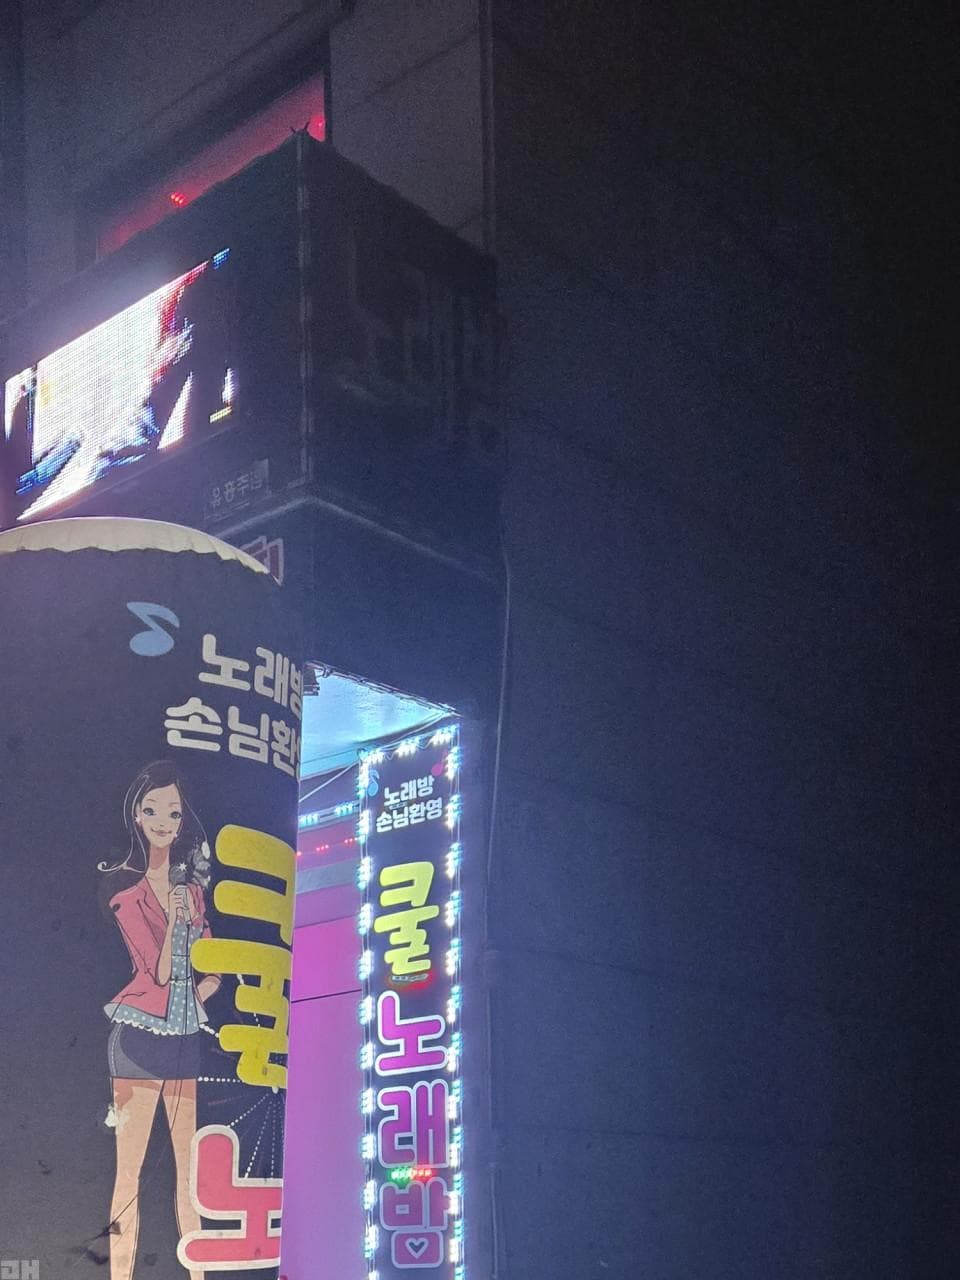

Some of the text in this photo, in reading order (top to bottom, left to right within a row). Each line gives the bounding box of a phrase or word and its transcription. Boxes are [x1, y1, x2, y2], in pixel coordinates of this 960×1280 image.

[163, 696, 301, 784] 손님환
[375, 797, 443, 834] 손님환영
[383, 773, 435, 806] 노래방
[373, 860, 440, 976] 쿨
[373, 990, 451, 1269] 노래방
